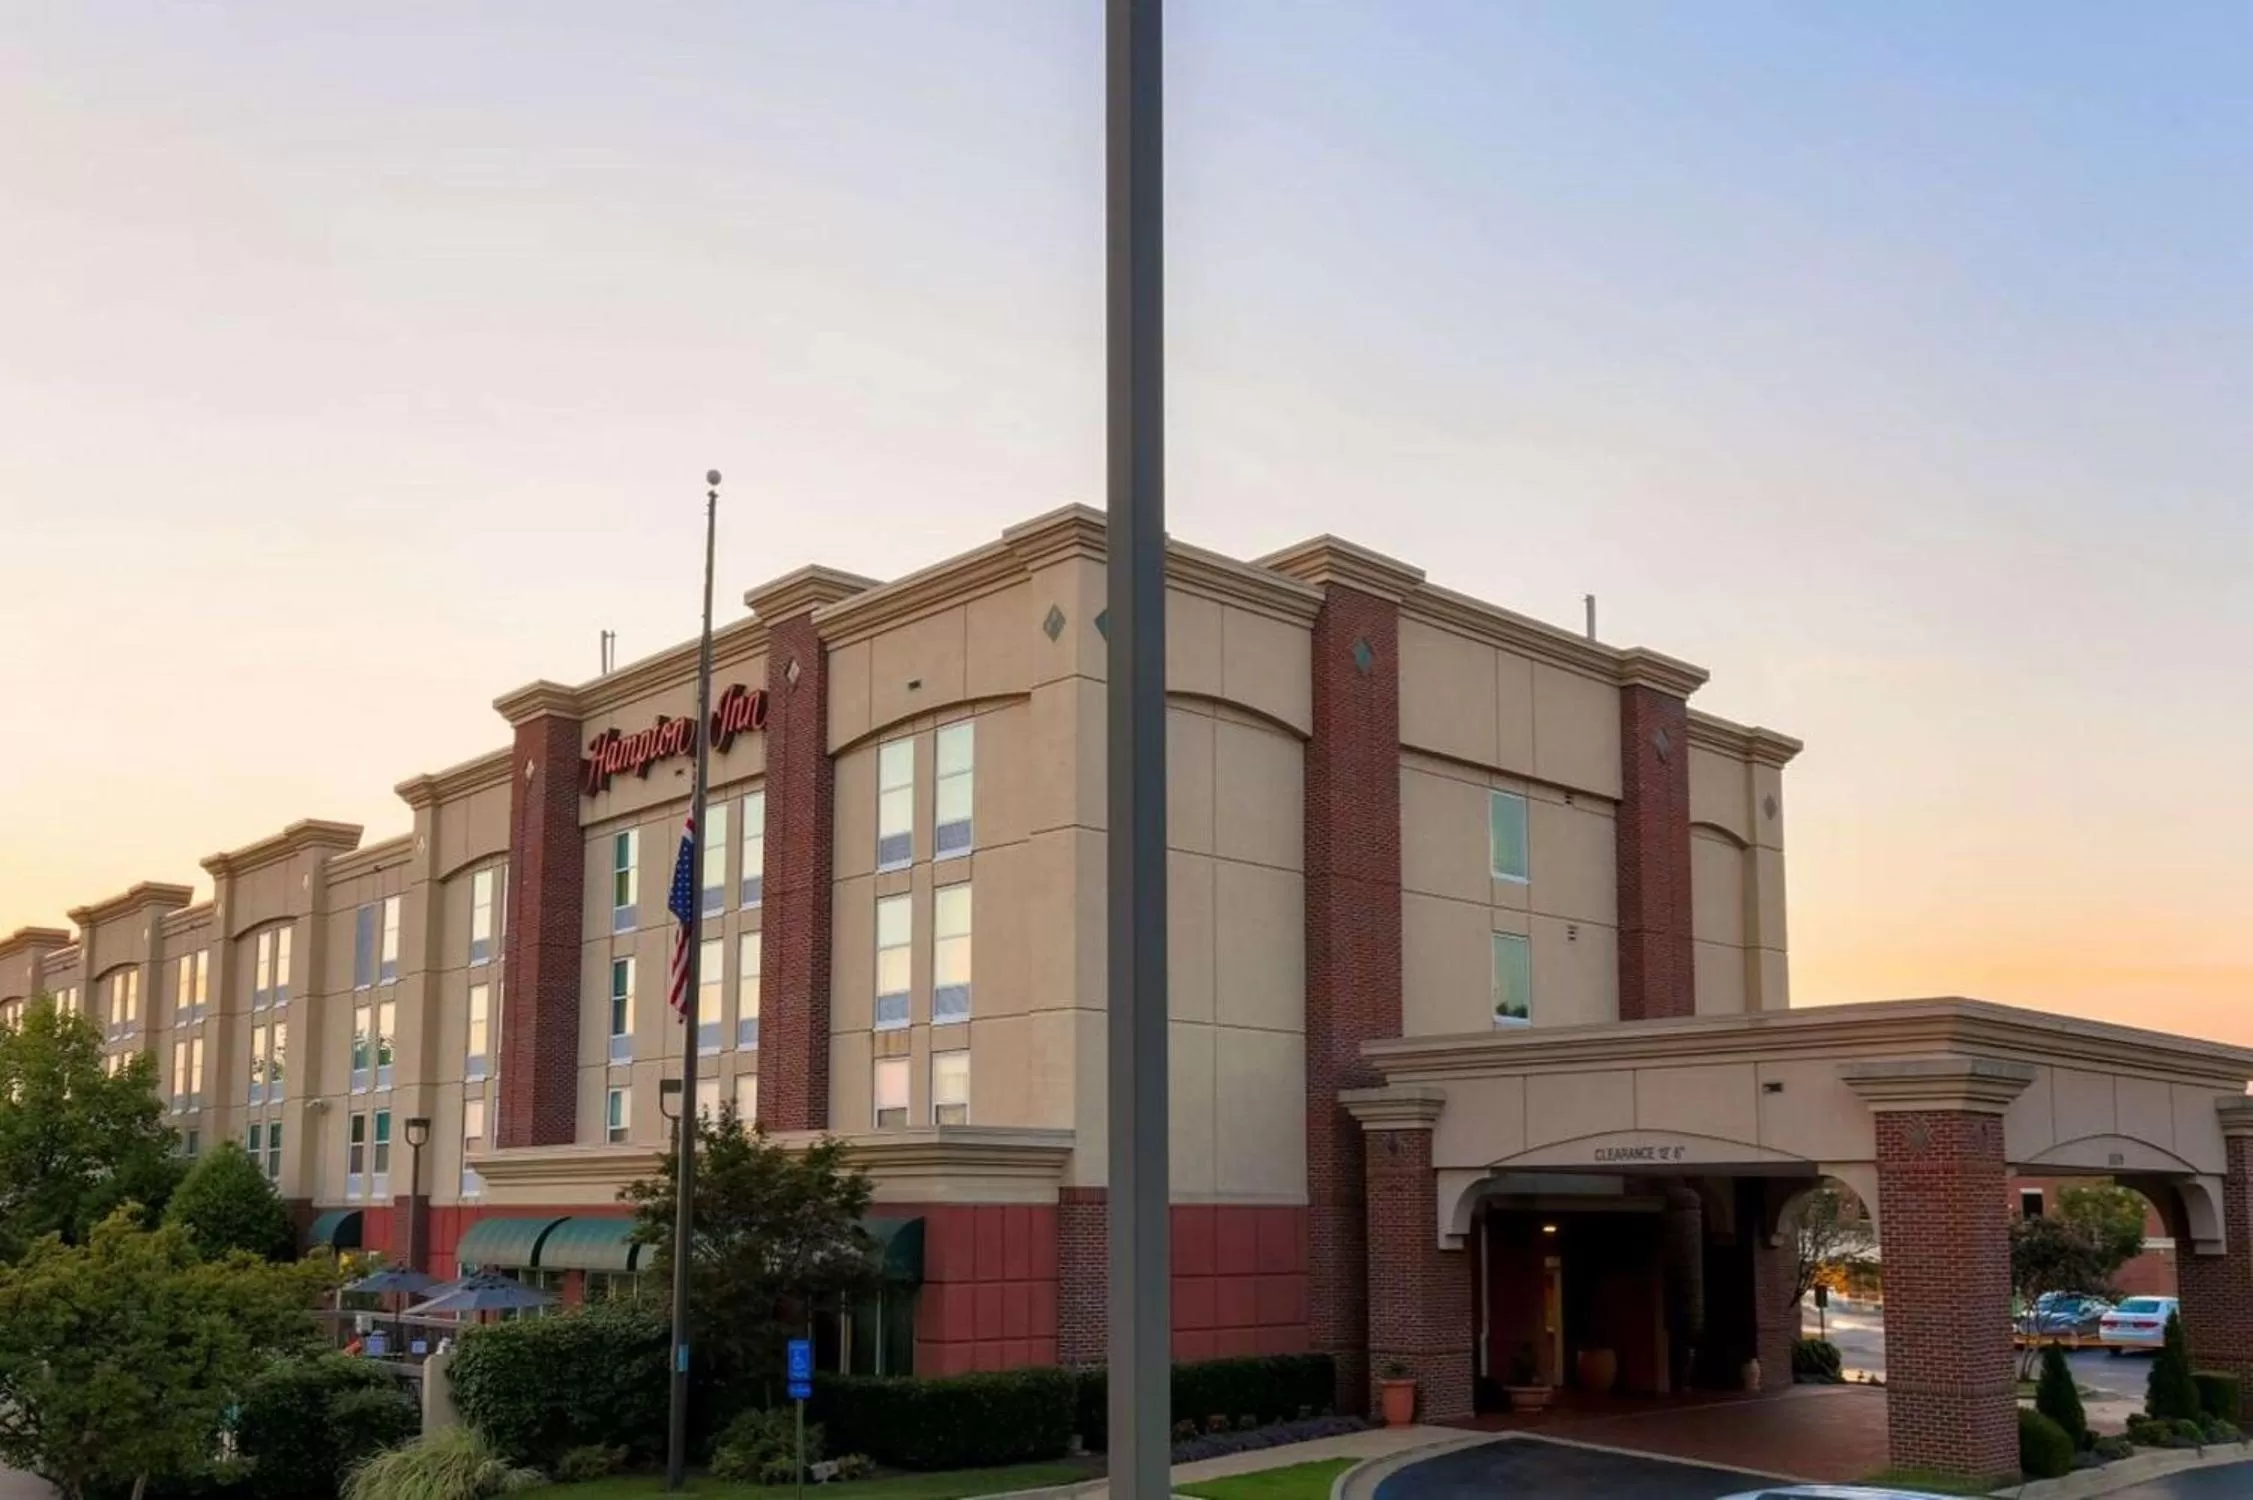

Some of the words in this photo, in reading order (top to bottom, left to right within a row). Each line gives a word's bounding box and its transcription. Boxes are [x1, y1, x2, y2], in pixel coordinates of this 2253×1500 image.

[582, 715, 697, 796] Hampton
[710, 684, 768, 753] Inn
[1594, 1147, 1656, 1162] CLEARANCE
